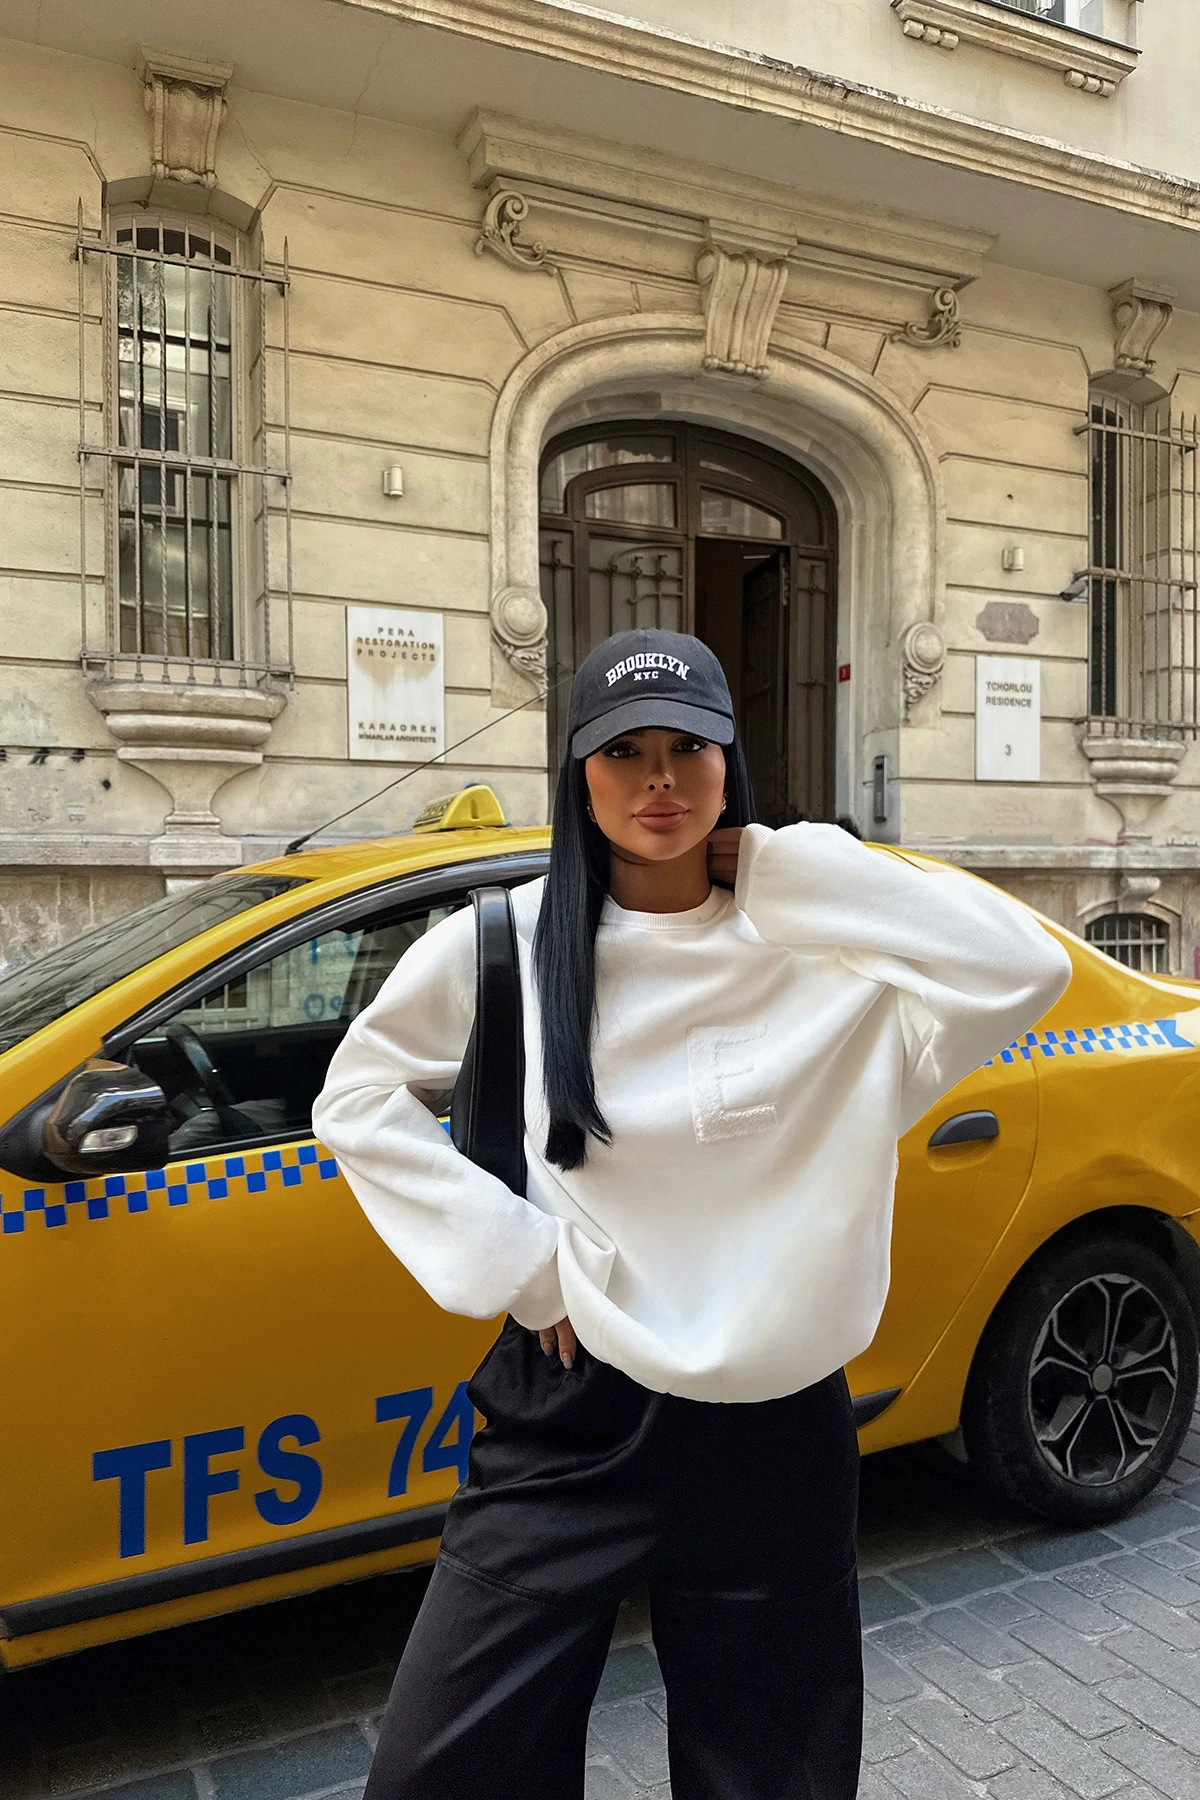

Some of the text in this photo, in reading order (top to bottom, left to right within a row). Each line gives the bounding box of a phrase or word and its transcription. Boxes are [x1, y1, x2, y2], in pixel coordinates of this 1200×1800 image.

[378, 628, 415, 637] PERA
[357, 638, 435, 649] RESTORATION
[357, 649, 435, 661] PROJECTS
[605, 652, 691, 687] BROOKLYN
[633, 671, 659, 682] NYC
[985, 681, 1033, 693] TCHORLOU
[985, 696, 1032, 708] RESIDENCE
[1004, 744, 1012, 757] 3
[91, 1379, 475, 1559] TFS 74
